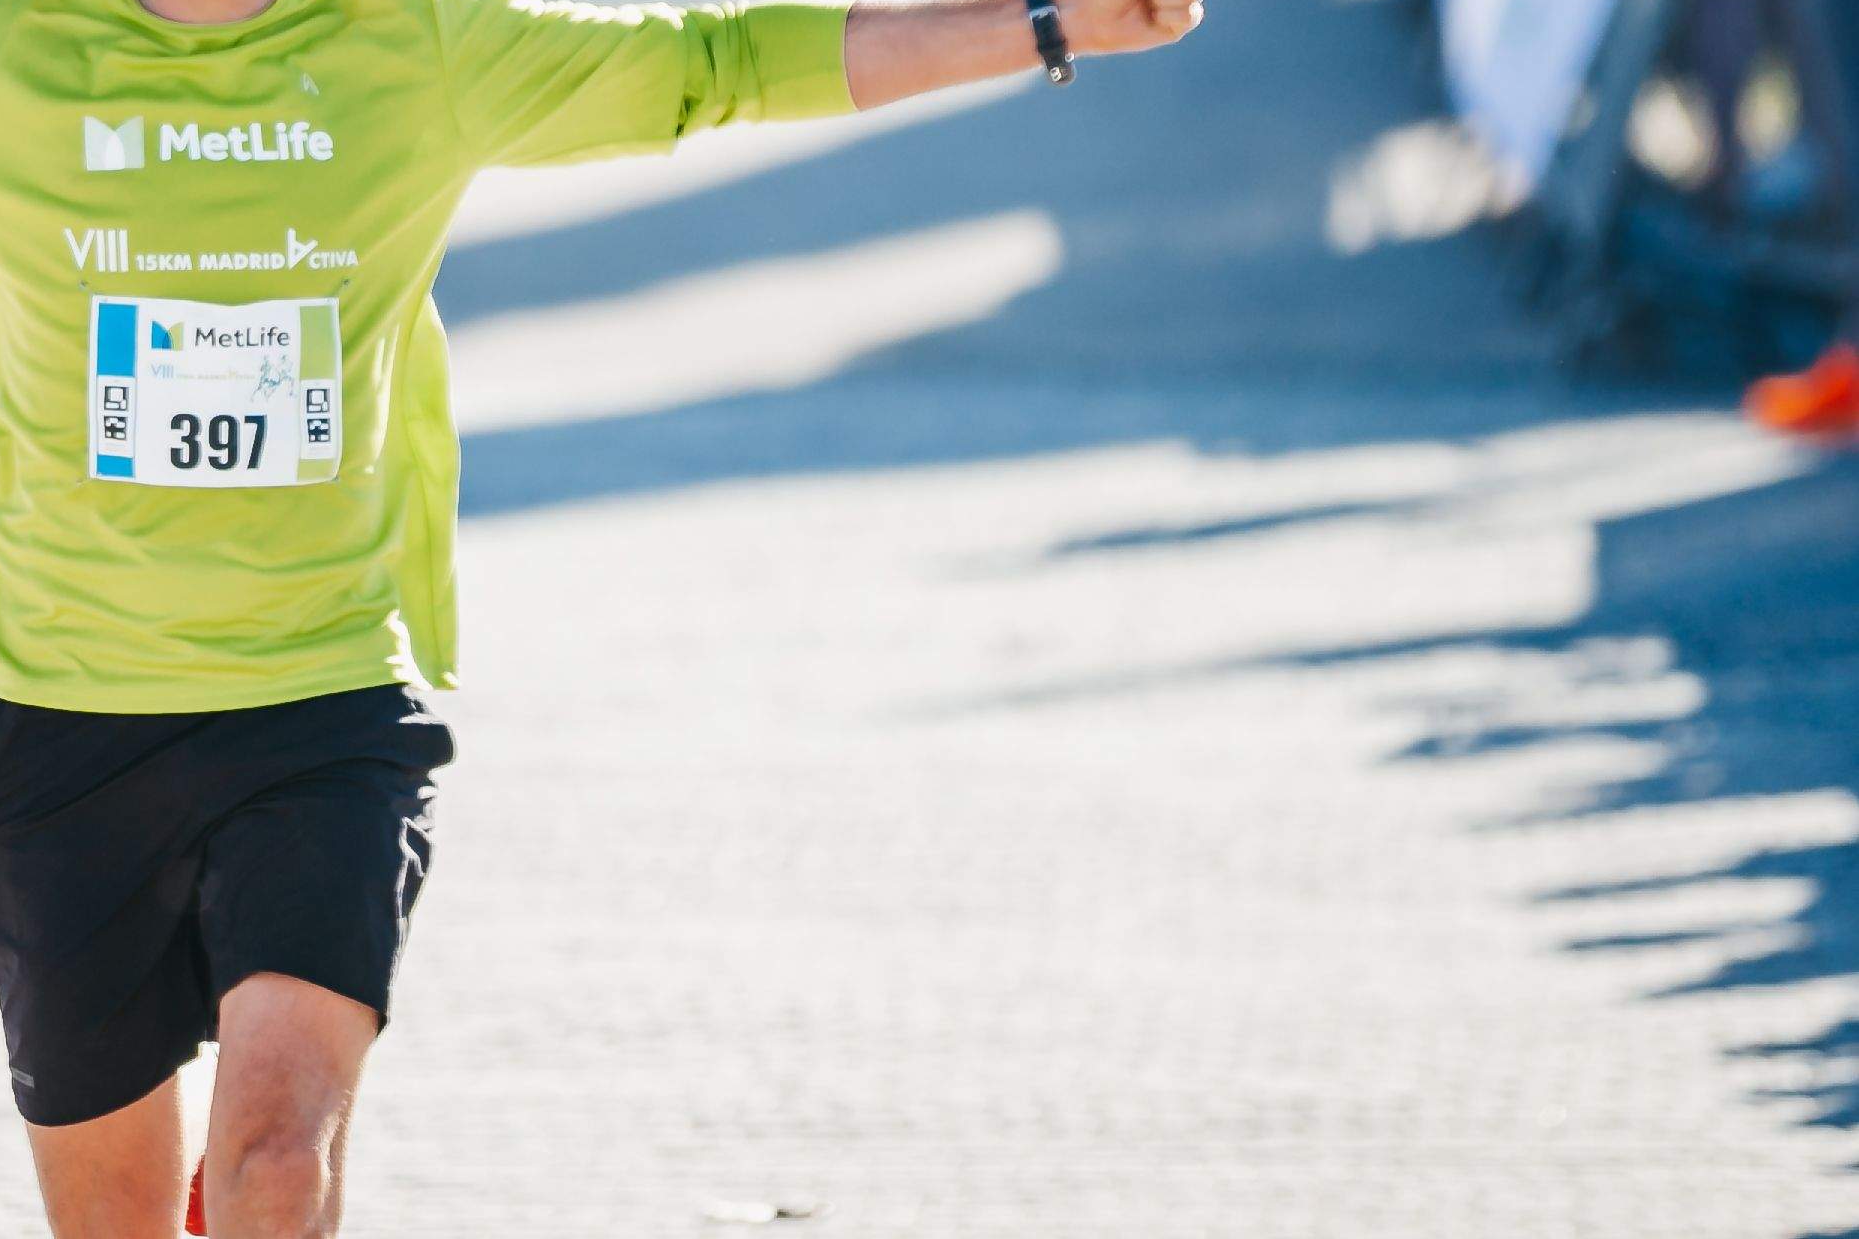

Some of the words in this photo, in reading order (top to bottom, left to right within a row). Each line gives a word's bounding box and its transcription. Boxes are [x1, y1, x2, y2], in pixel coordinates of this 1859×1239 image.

[158, 121, 335, 162] MetLife
[63, 227, 130, 272] VIII
[135, 253, 193, 271] 15KM
[195, 327, 290, 348] MetLife
[170, 413, 268, 471] 397
